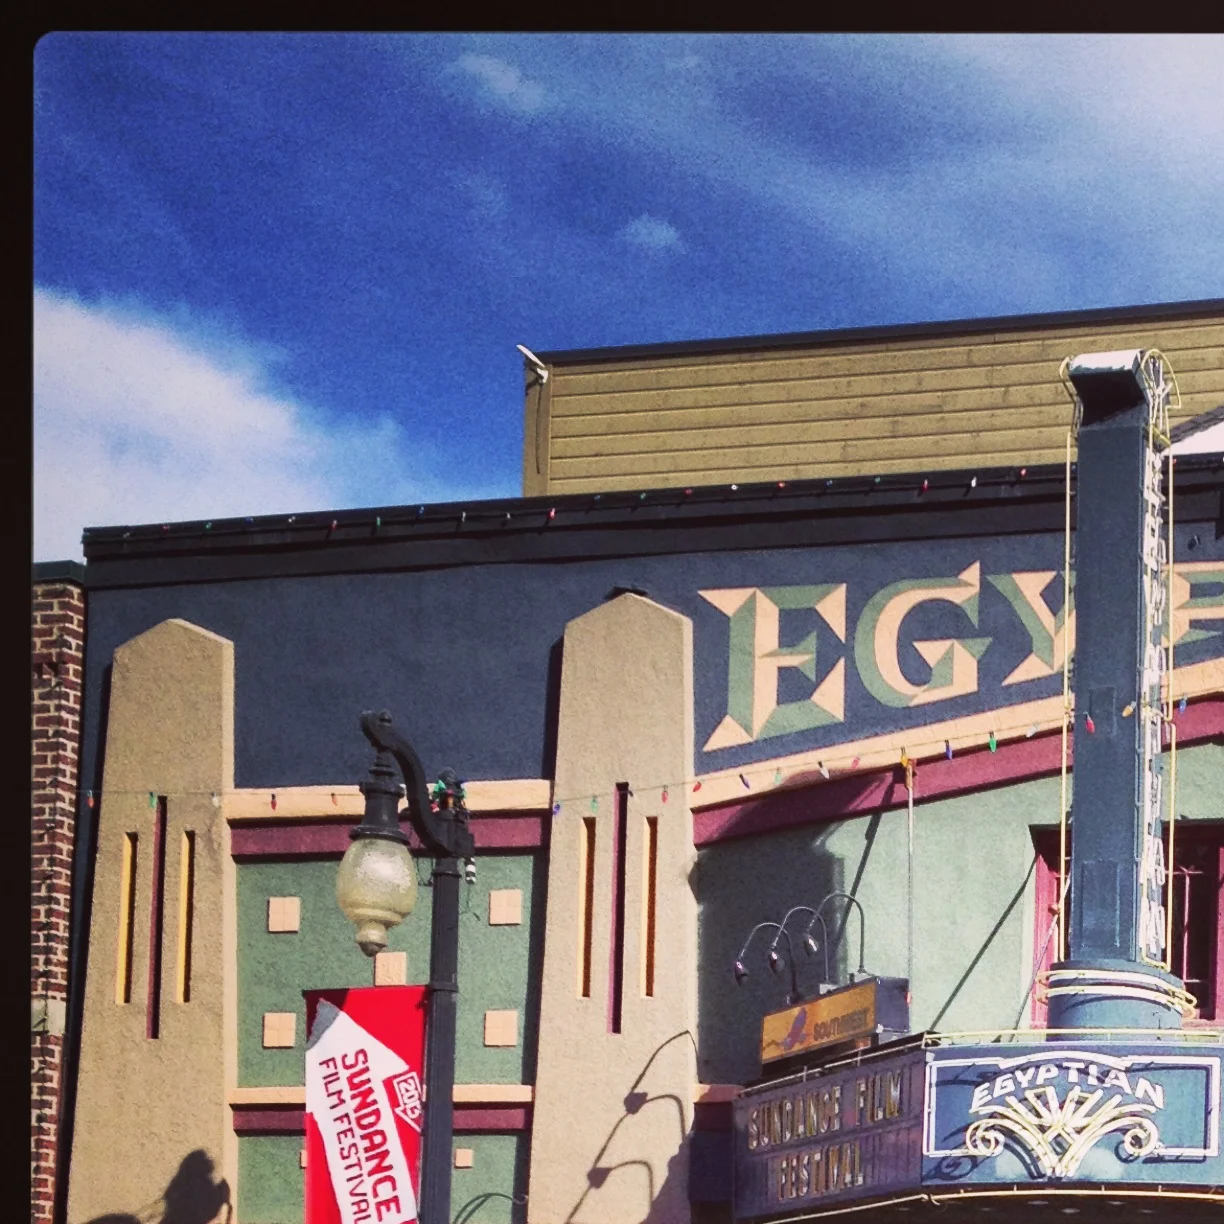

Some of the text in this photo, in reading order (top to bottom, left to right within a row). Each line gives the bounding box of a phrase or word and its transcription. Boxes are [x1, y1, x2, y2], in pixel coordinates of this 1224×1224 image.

[318, 1057, 347, 1111] FILM
[748, 1069, 902, 1151] SUNDANCE FILM
[968, 1061, 1165, 1114] EGYPTIAN
[341, 1048, 402, 1223] SUNDANCE
[778, 1140, 865, 1202] FESTIVAL
